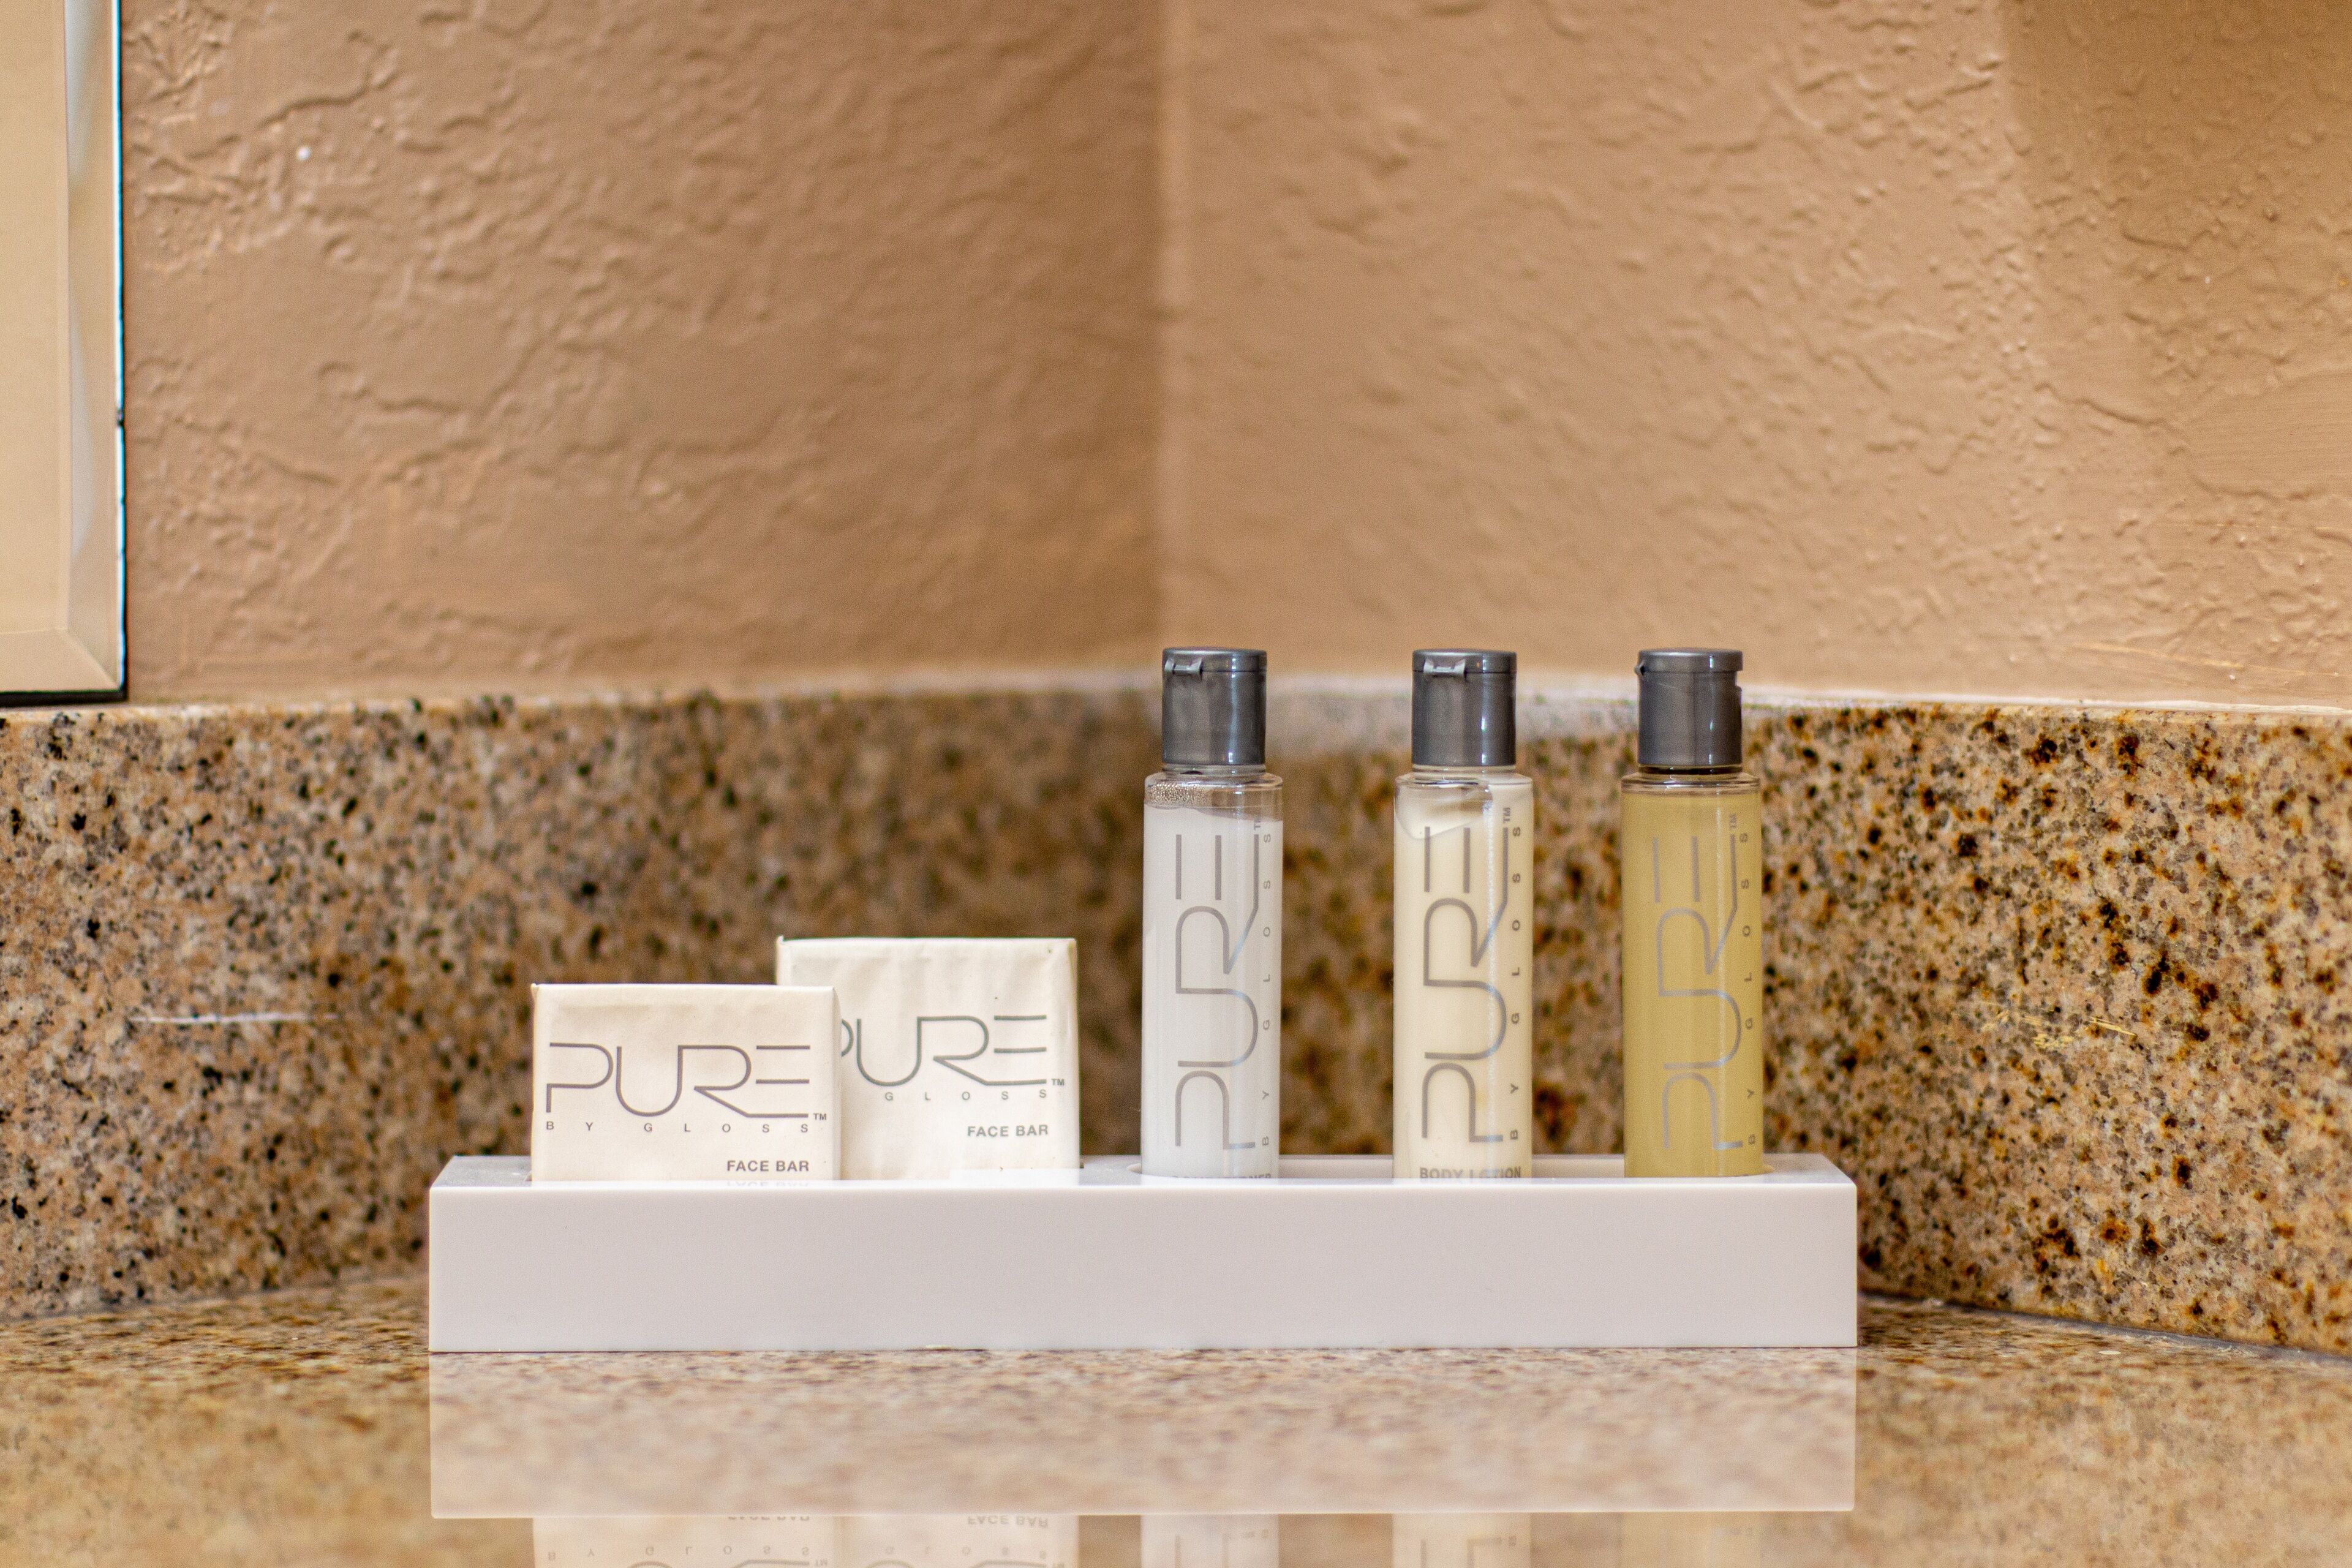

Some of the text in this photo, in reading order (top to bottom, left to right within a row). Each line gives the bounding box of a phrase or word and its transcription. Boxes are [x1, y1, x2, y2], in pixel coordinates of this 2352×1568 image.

[1175, 834, 1259, 1150] PURE
[1262, 834, 1272, 1147] BY GLOSS
[1422, 826, 1509, 1143] PURE
[1510, 826, 1521, 1140] BY GLOSS
[1653, 834, 1744, 1150] PURE
[546, 1042, 827, 1121] PURE TM
[546, 1121, 809, 1133] BY GLOSS
[727, 1159, 810, 1172] FACE BAR
[884, 1089, 1047, 1101] GLOSS
[967, 1124, 1049, 1137] FACE BAR
